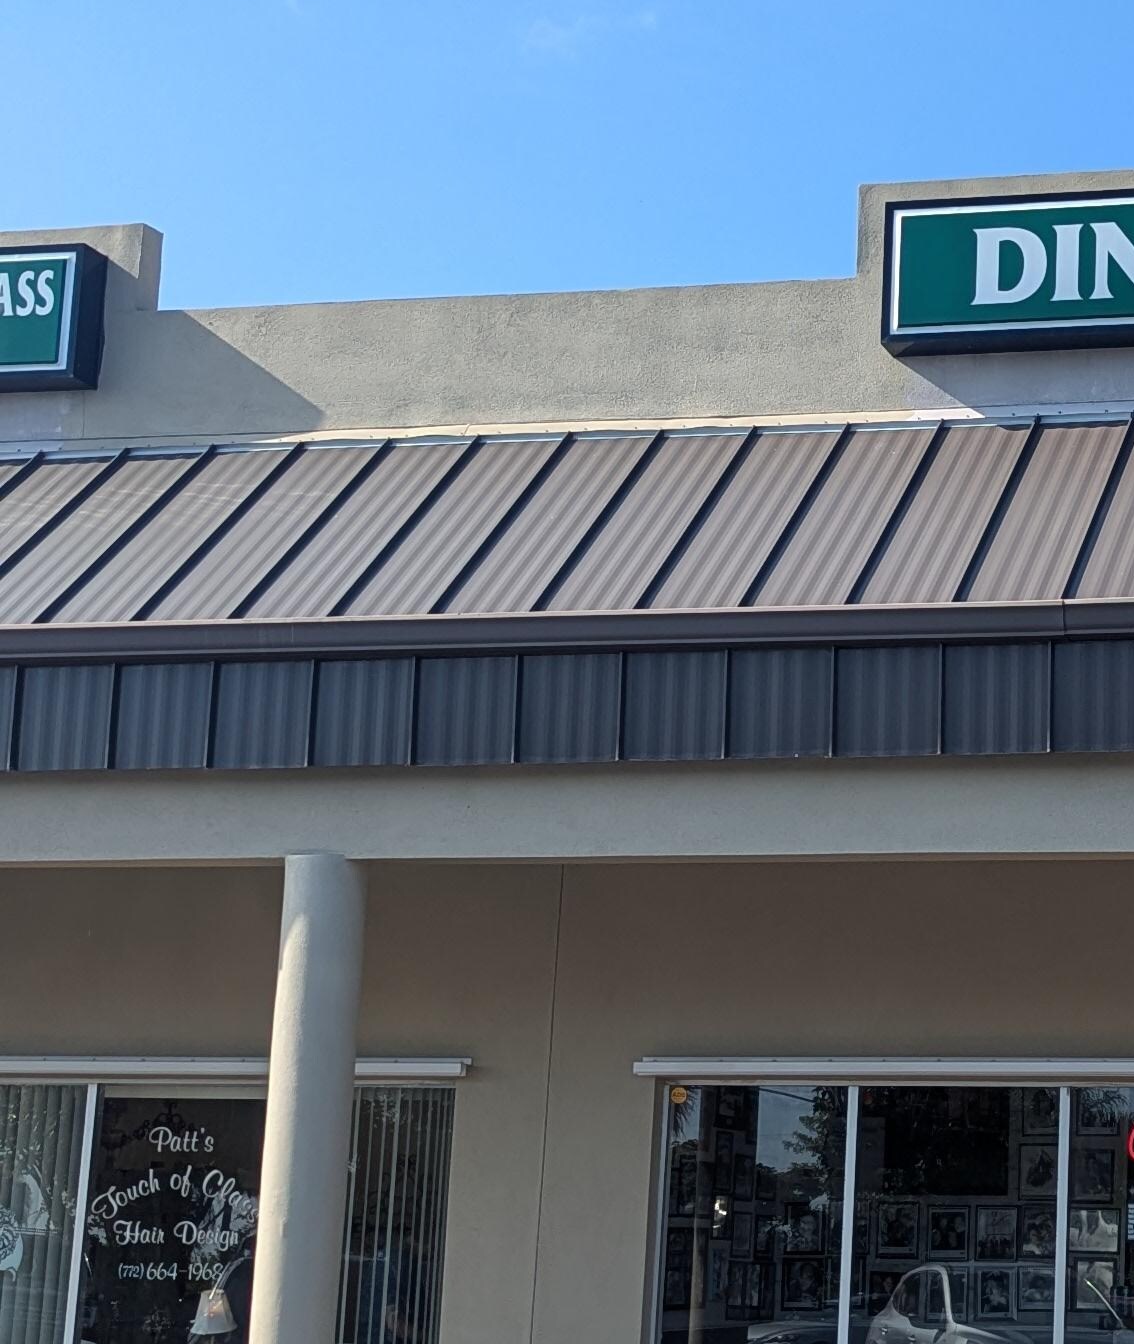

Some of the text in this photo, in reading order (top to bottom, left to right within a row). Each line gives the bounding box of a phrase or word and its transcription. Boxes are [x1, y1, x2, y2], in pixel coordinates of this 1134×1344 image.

[149, 1126, 215, 1153] Patt's
[91, 1168, 161, 1219] Touch
[170, 1165, 193, 1197] of
[113, 1220, 240, 1252] Hair Design
[118, 1262, 224, 1281] (772) 664-1968
